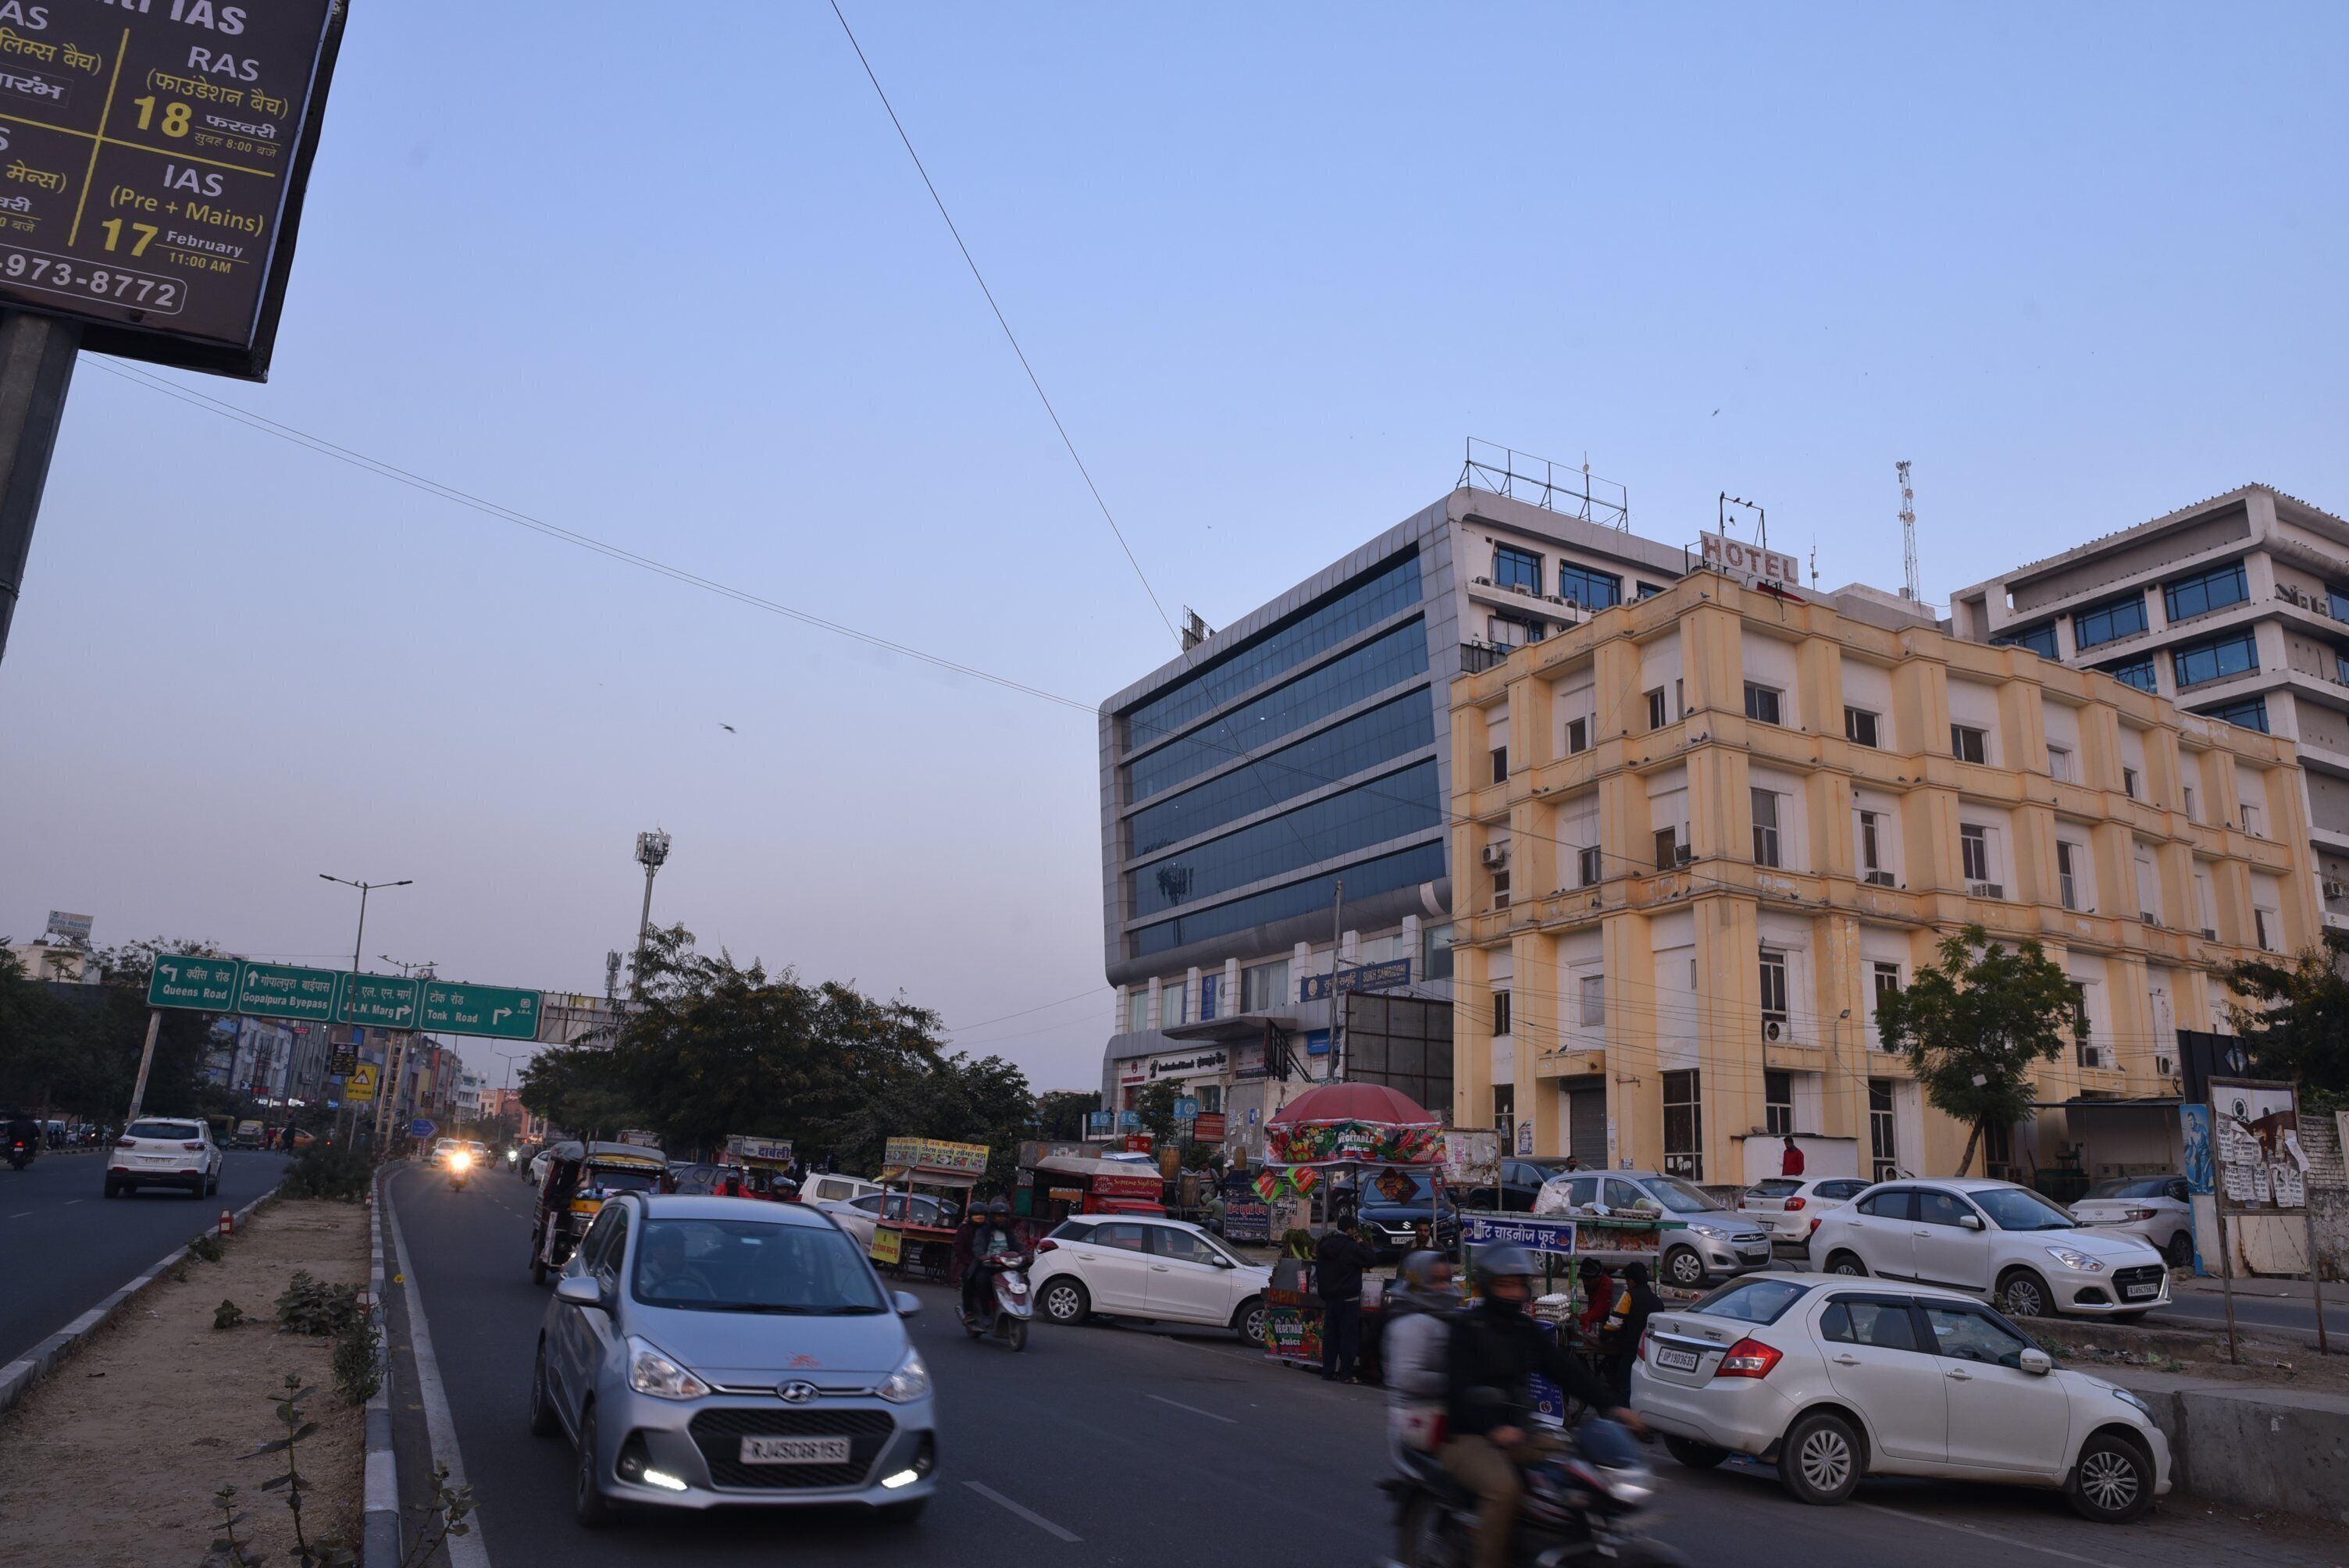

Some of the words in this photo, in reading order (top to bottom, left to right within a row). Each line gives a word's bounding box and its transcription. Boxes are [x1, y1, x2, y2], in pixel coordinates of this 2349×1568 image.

[169, 0, 247, 35] IAS
[187, 46, 260, 82] RAS
[250, 88, 289, 119] बैच)
[134, 95, 193, 138] 18
[205, 114, 277, 140] फरवरी
[226, 138, 252, 154] 8:00
[162, 164, 224, 198] IAS
[109, 184, 159, 213] (Pre
[165, 200, 180, 216] +
[185, 201, 264, 237] Mains)
[101, 218, 159, 258] 17
[166, 230, 244, 258] February
[169, 252, 207, 270] 11:00
[209, 258, 232, 274] AM
[0, 254, 177, 308] 973-8772
[1703, 535, 1797, 584] HOTEL
[216, 968, 230, 982] रोड
[260, 973, 297, 992] गोपालपुरा
[301, 977, 330, 993] बाईपास
[1363, 969, 1376, 982] SUKH
[162, 984, 198, 998] Queens
[203, 988, 227, 1000] Road
[242, 992, 287, 1007] Gopalpura
[289, 996, 328, 1010] Byepass
[397, 986, 412, 1000] मार्ग
[430, 991, 446, 1003] टोंक
[451, 992, 465, 1005] रोड
[344, 1002, 369, 1014] JL.N.
[372, 1004, 394, 1018] Marg
[427, 1009, 447, 1021] Tonk
[455, 1012, 478, 1024] Road
[1338, 1134, 1374, 1144] VEGETABLE
[1113, 1178, 1136, 1186] Supreme
[1538, 1229, 1556, 1249] फूड
[1274, 1324, 1303, 1335] VEGETABLE
[1279, 1338, 1301, 1346] Juice
